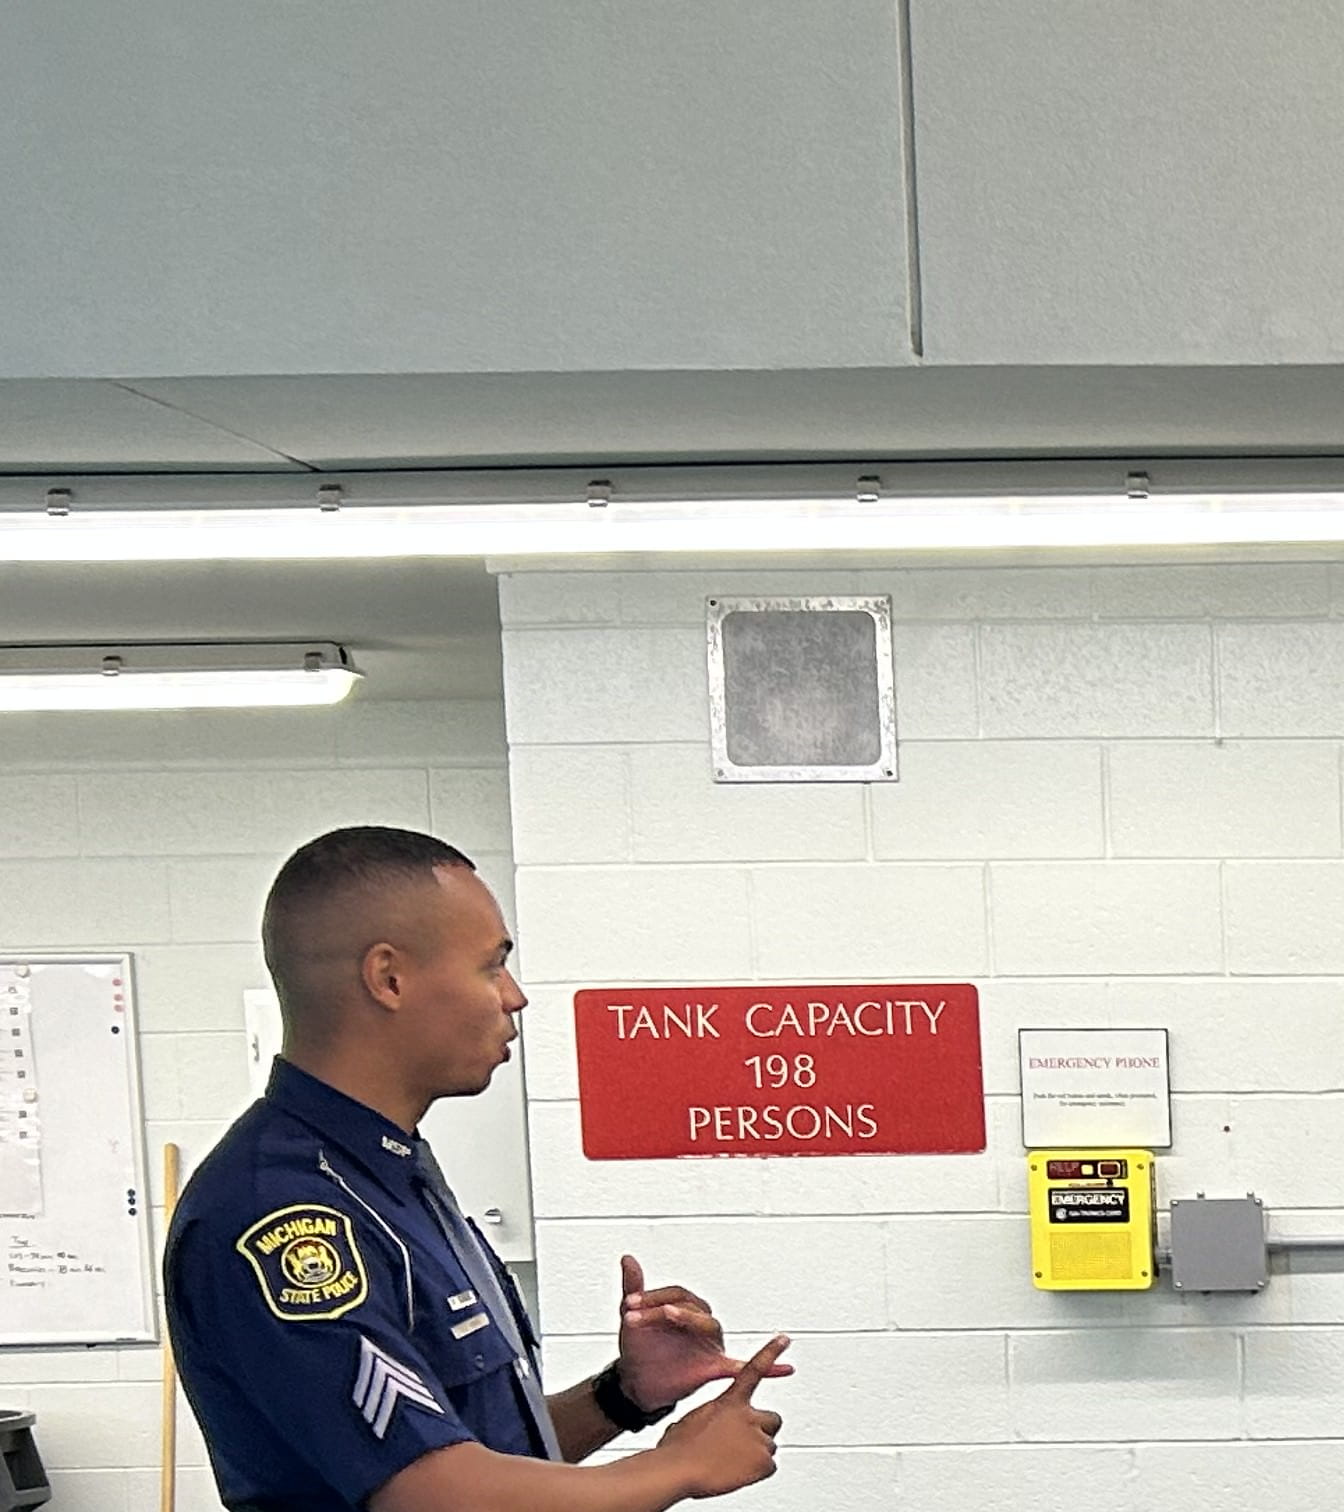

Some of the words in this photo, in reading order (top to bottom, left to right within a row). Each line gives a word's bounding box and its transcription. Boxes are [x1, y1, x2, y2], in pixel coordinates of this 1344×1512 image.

[608, 1003, 720, 1039] TANK
[745, 1001, 946, 1038] CAPACITY
[744, 1054, 817, 1089] 198
[1029, 1057, 1111, 1069] EMERGENCY
[1115, 1057, 1160, 1069] PHONE
[689, 1104, 878, 1141] PERSONS
[255, 1217, 337, 1256] MICHIGAN
[279, 1287, 322, 1305] STATE
[321, 1270, 359, 1300] POLICE
